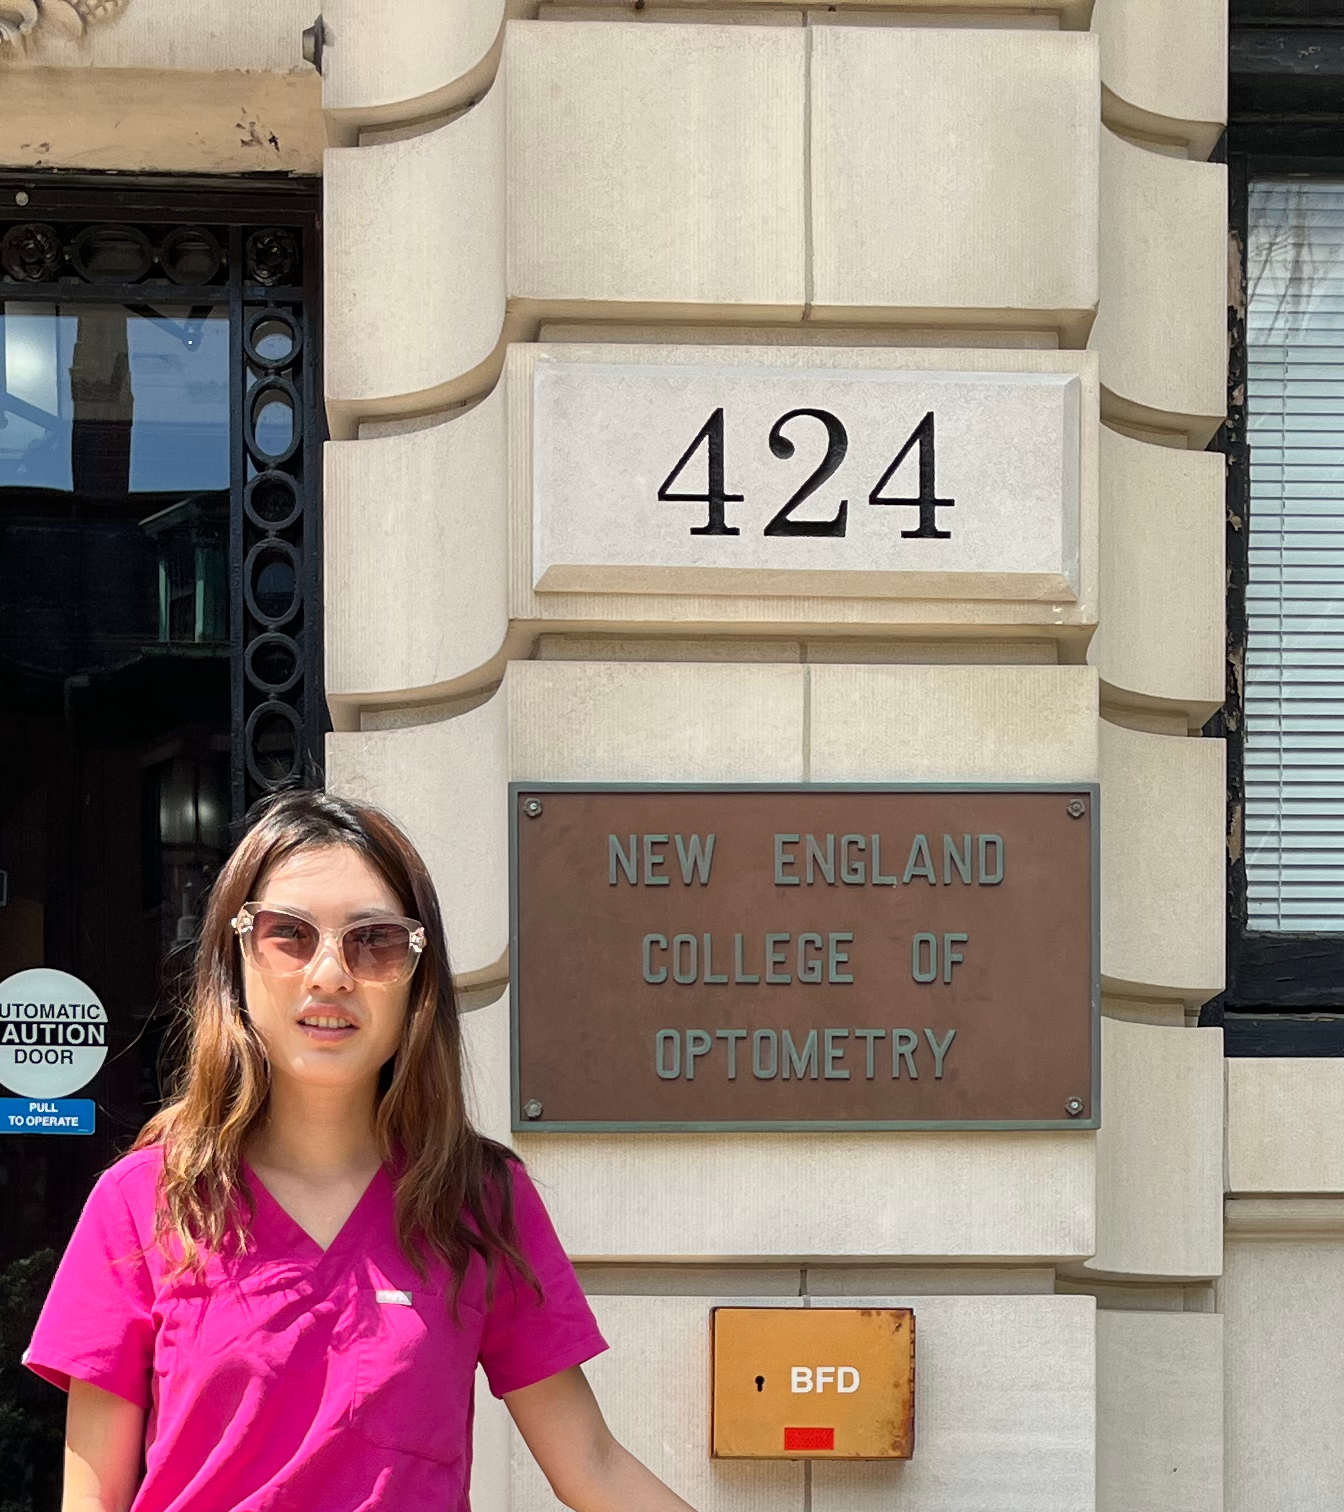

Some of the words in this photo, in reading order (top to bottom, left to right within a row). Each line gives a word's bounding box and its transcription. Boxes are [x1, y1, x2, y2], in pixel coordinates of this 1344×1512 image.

[657, 406, 956, 540] 424
[608, 833, 717, 886] NEW
[773, 832, 1006, 886] ENGLAND
[642, 931, 855, 985] COLLEGE
[911, 931, 969, 984] OF
[14, 1048, 74, 1065] DOOR
[654, 1027, 958, 1080] OPTOMETRY
[7, 1115, 25, 1126] TO
[25, 1115, 79, 1127] OPERATE
[28, 1102, 59, 1113] PULL
[790, 1366, 861, 1394] BFD
